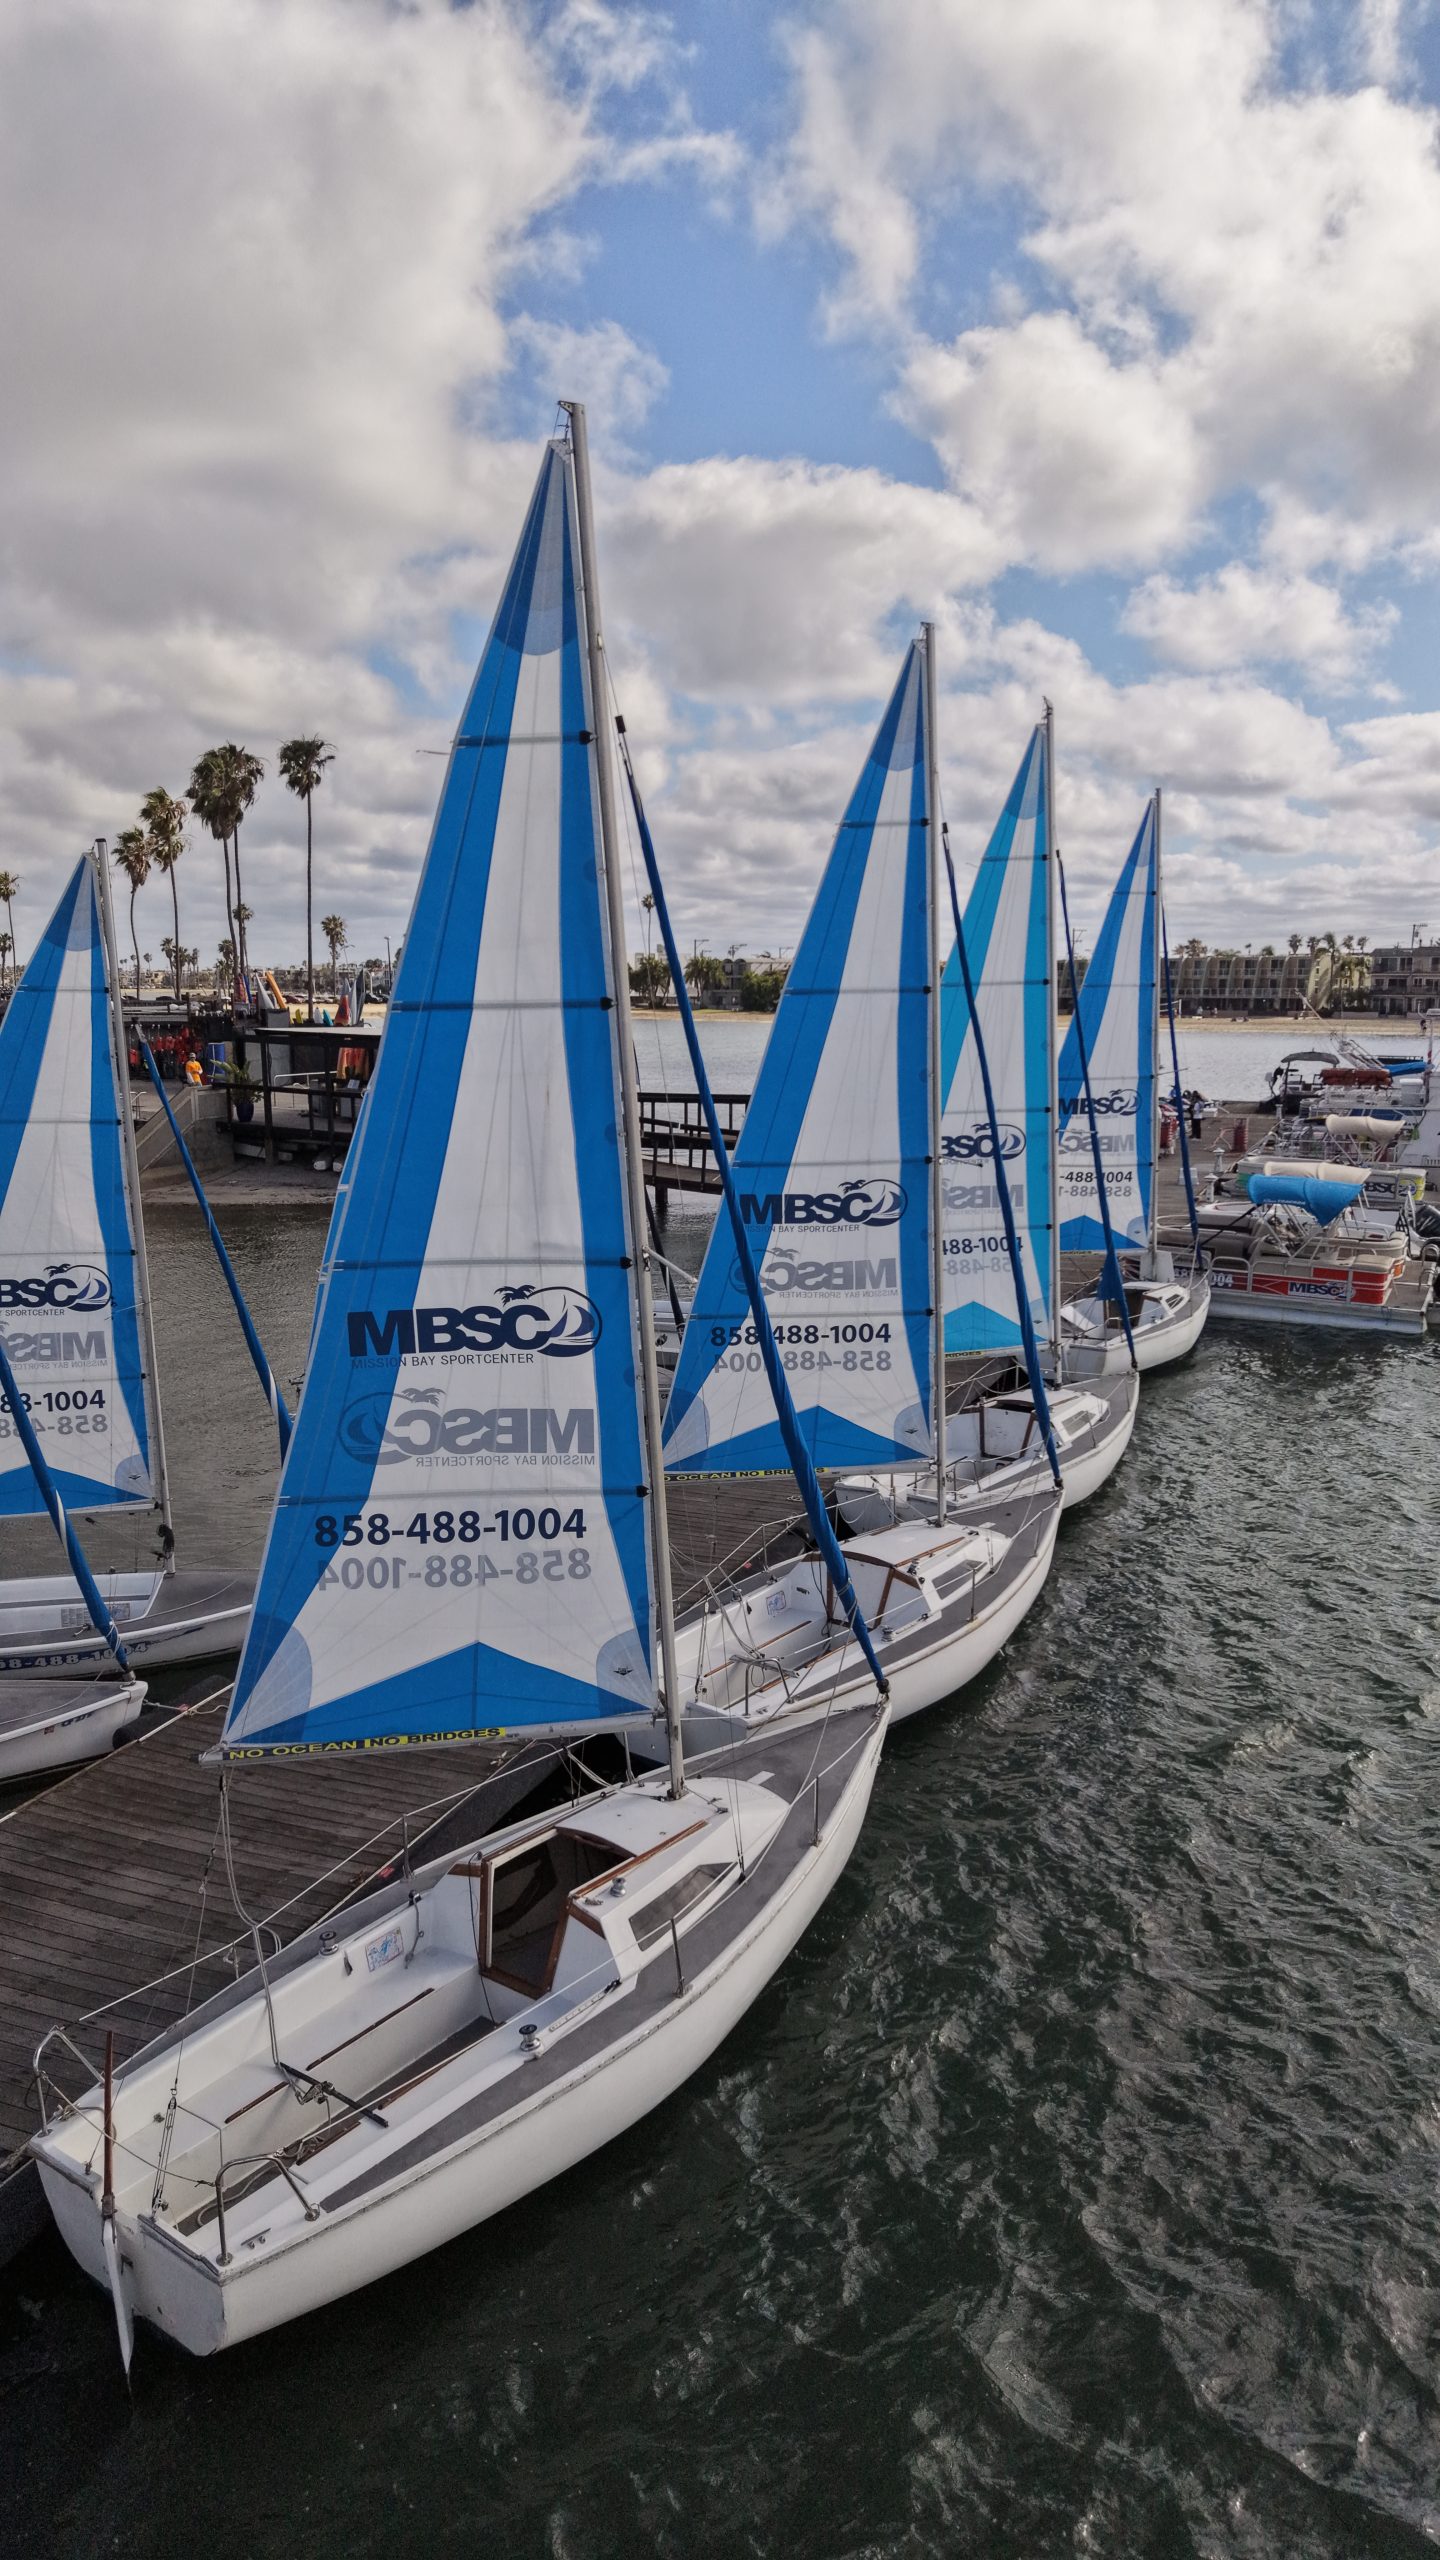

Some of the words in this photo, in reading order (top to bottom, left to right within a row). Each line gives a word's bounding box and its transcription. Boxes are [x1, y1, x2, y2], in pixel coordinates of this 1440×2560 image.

[1059, 1097, 1125, 1115] MBSC
[740, 1193, 873, 1225] MBSC
[778, 1225, 795, 1233] BAY
[798, 1224, 860, 1233] SPORTCENTER
[5, 1309, 65, 1317] SPORTCENTER
[347, 1305, 551, 1357] MBSC
[710, 1323, 892, 1346] 858488-1004
[352, 1354, 407, 1370] MISSION
[411, 1355, 436, 1367] BAY
[440, 1353, 534, 1366] SPORTCENTER
[677, 1471, 732, 1481] OCEAN
[739, 1470, 761, 1478] NO
[763, 1467, 826, 1476] BRIDS
[314, 1508, 587, 1547] 858-488-1004
[229, 1748, 265, 1760] NO
[272, 1740, 357, 1756] OCEAN
[369, 1736, 401, 1748] NO
[406, 1728, 502, 1744] BRIDGES
